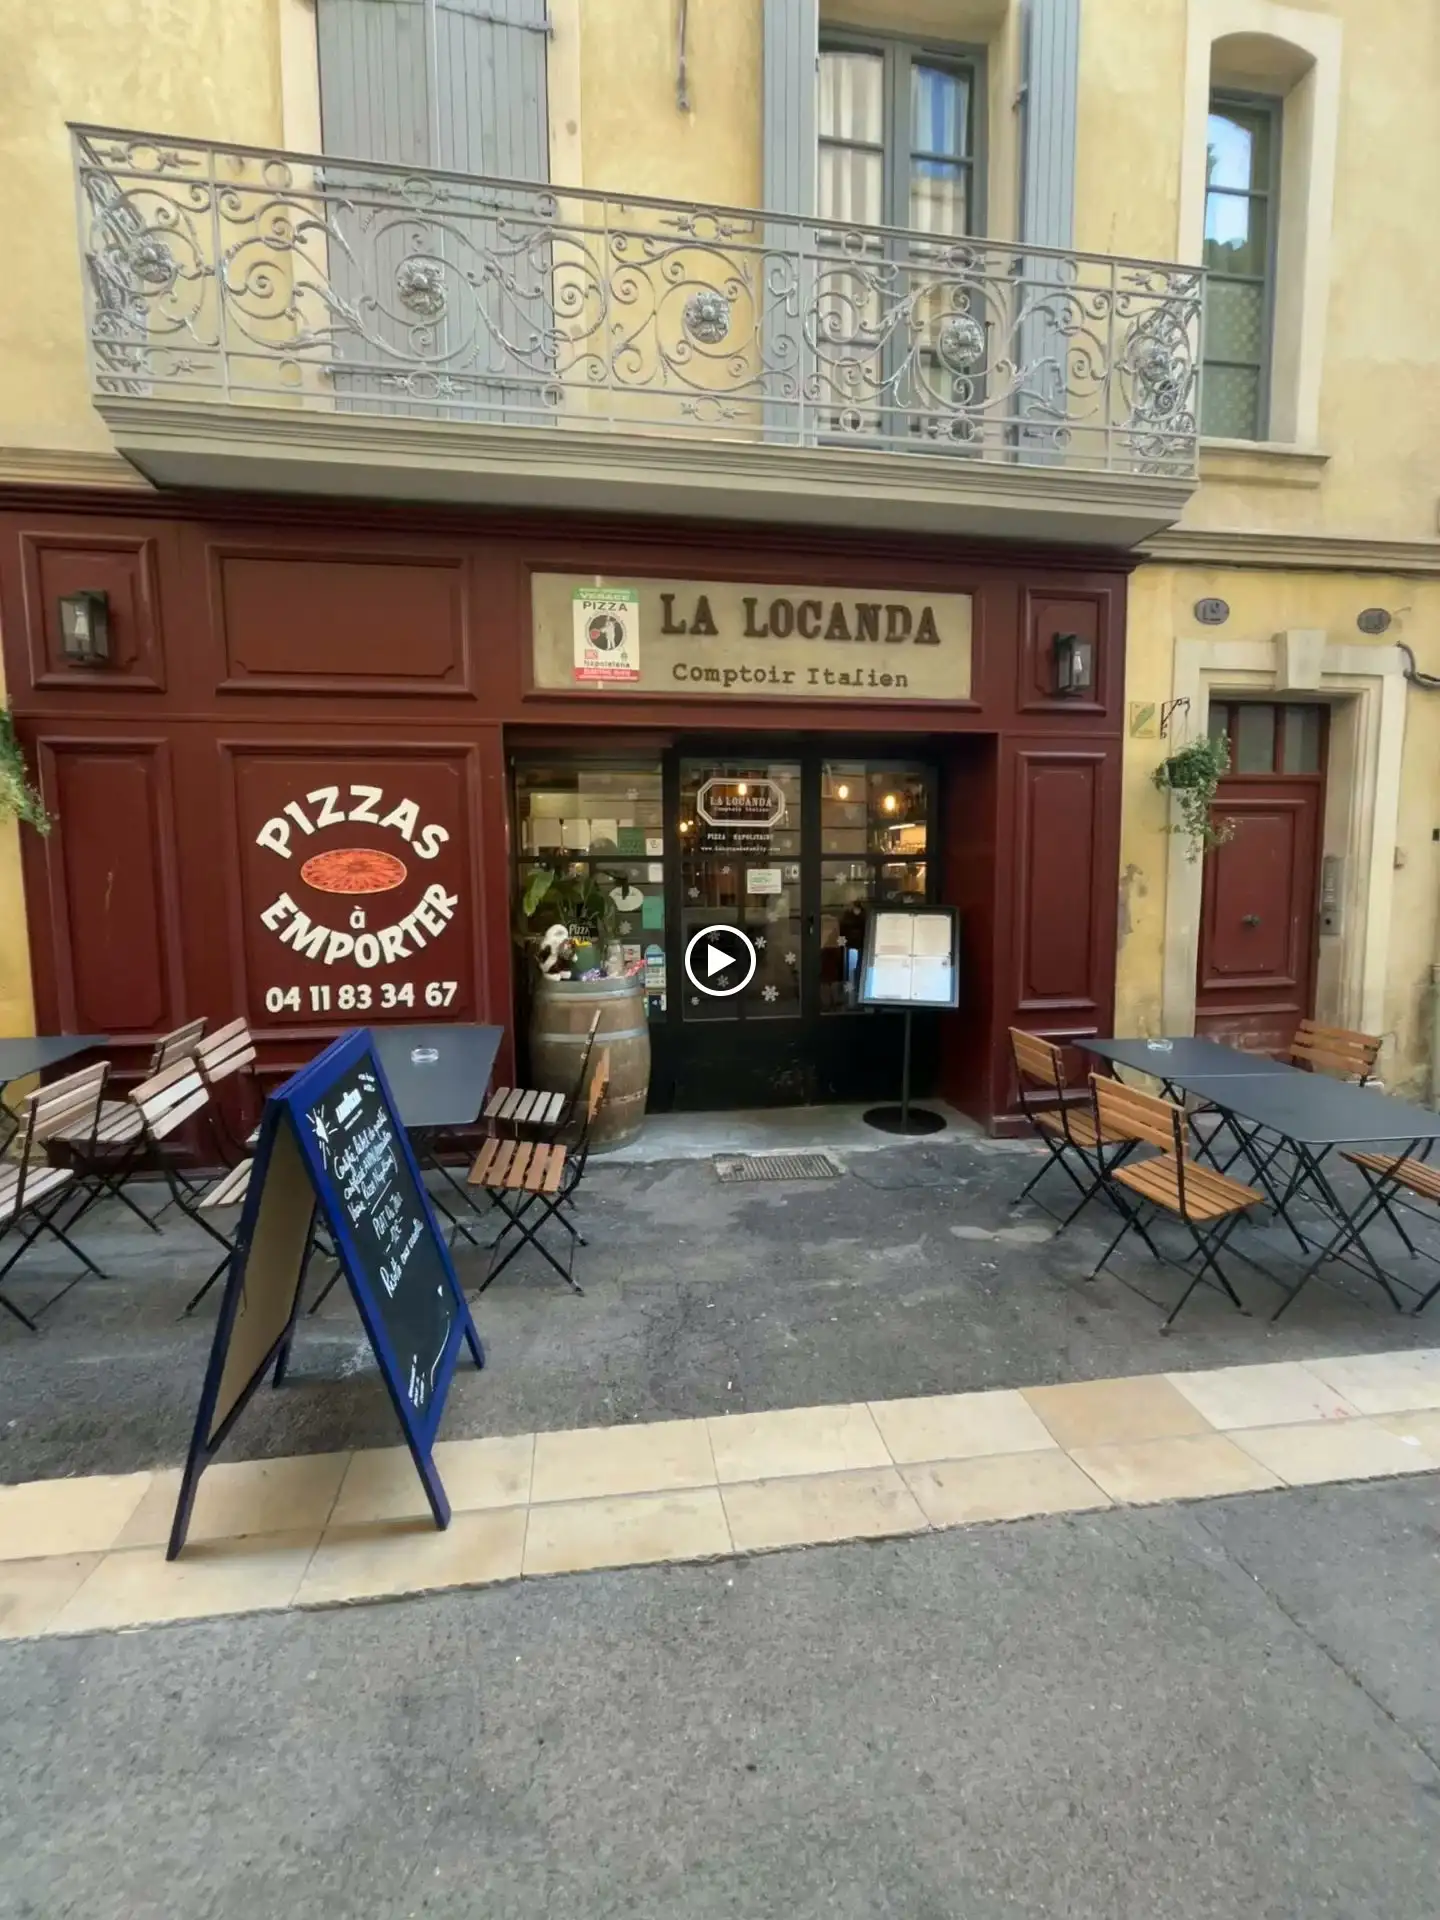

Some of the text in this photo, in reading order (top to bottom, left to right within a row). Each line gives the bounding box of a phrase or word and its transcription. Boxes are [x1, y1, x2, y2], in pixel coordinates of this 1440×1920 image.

[583, 601, 628, 611] PIZZA
[660, 593, 941, 644] LA LOCANDA
[672, 663, 909, 687] Comptoir Italien
[710, 797, 772, 807] LA LOCANDA
[255, 784, 450, 859] PIZZAS
[260, 883, 459, 969] EMPORTER
[350, 905, 366, 929] à
[265, 981, 458, 1013] 04 11 83 34 67
